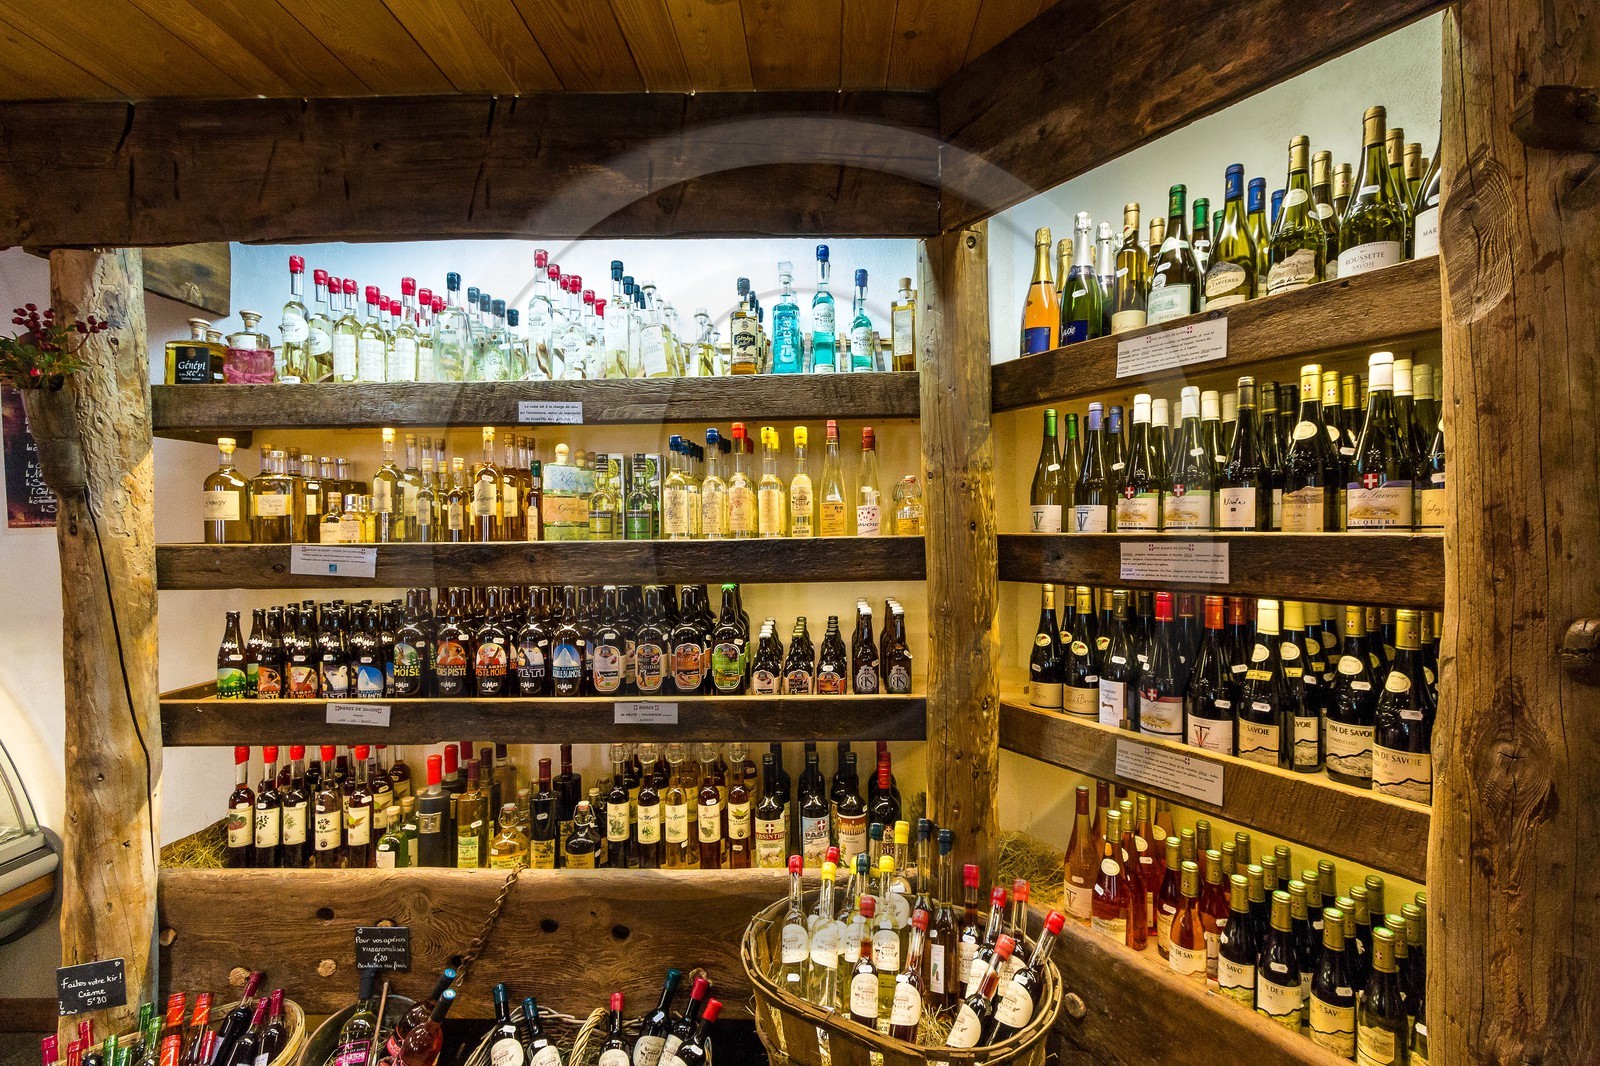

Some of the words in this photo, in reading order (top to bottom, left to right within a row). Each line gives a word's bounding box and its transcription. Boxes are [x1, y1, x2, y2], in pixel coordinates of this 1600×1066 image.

[1423, 227, 1437, 236] MAR
[1338, 727, 1348, 735] DE
[1350, 729, 1373, 738] SAVOI
[1391, 754, 1422, 767] SAVOIE
[60, 977, 87, 989] Faites
